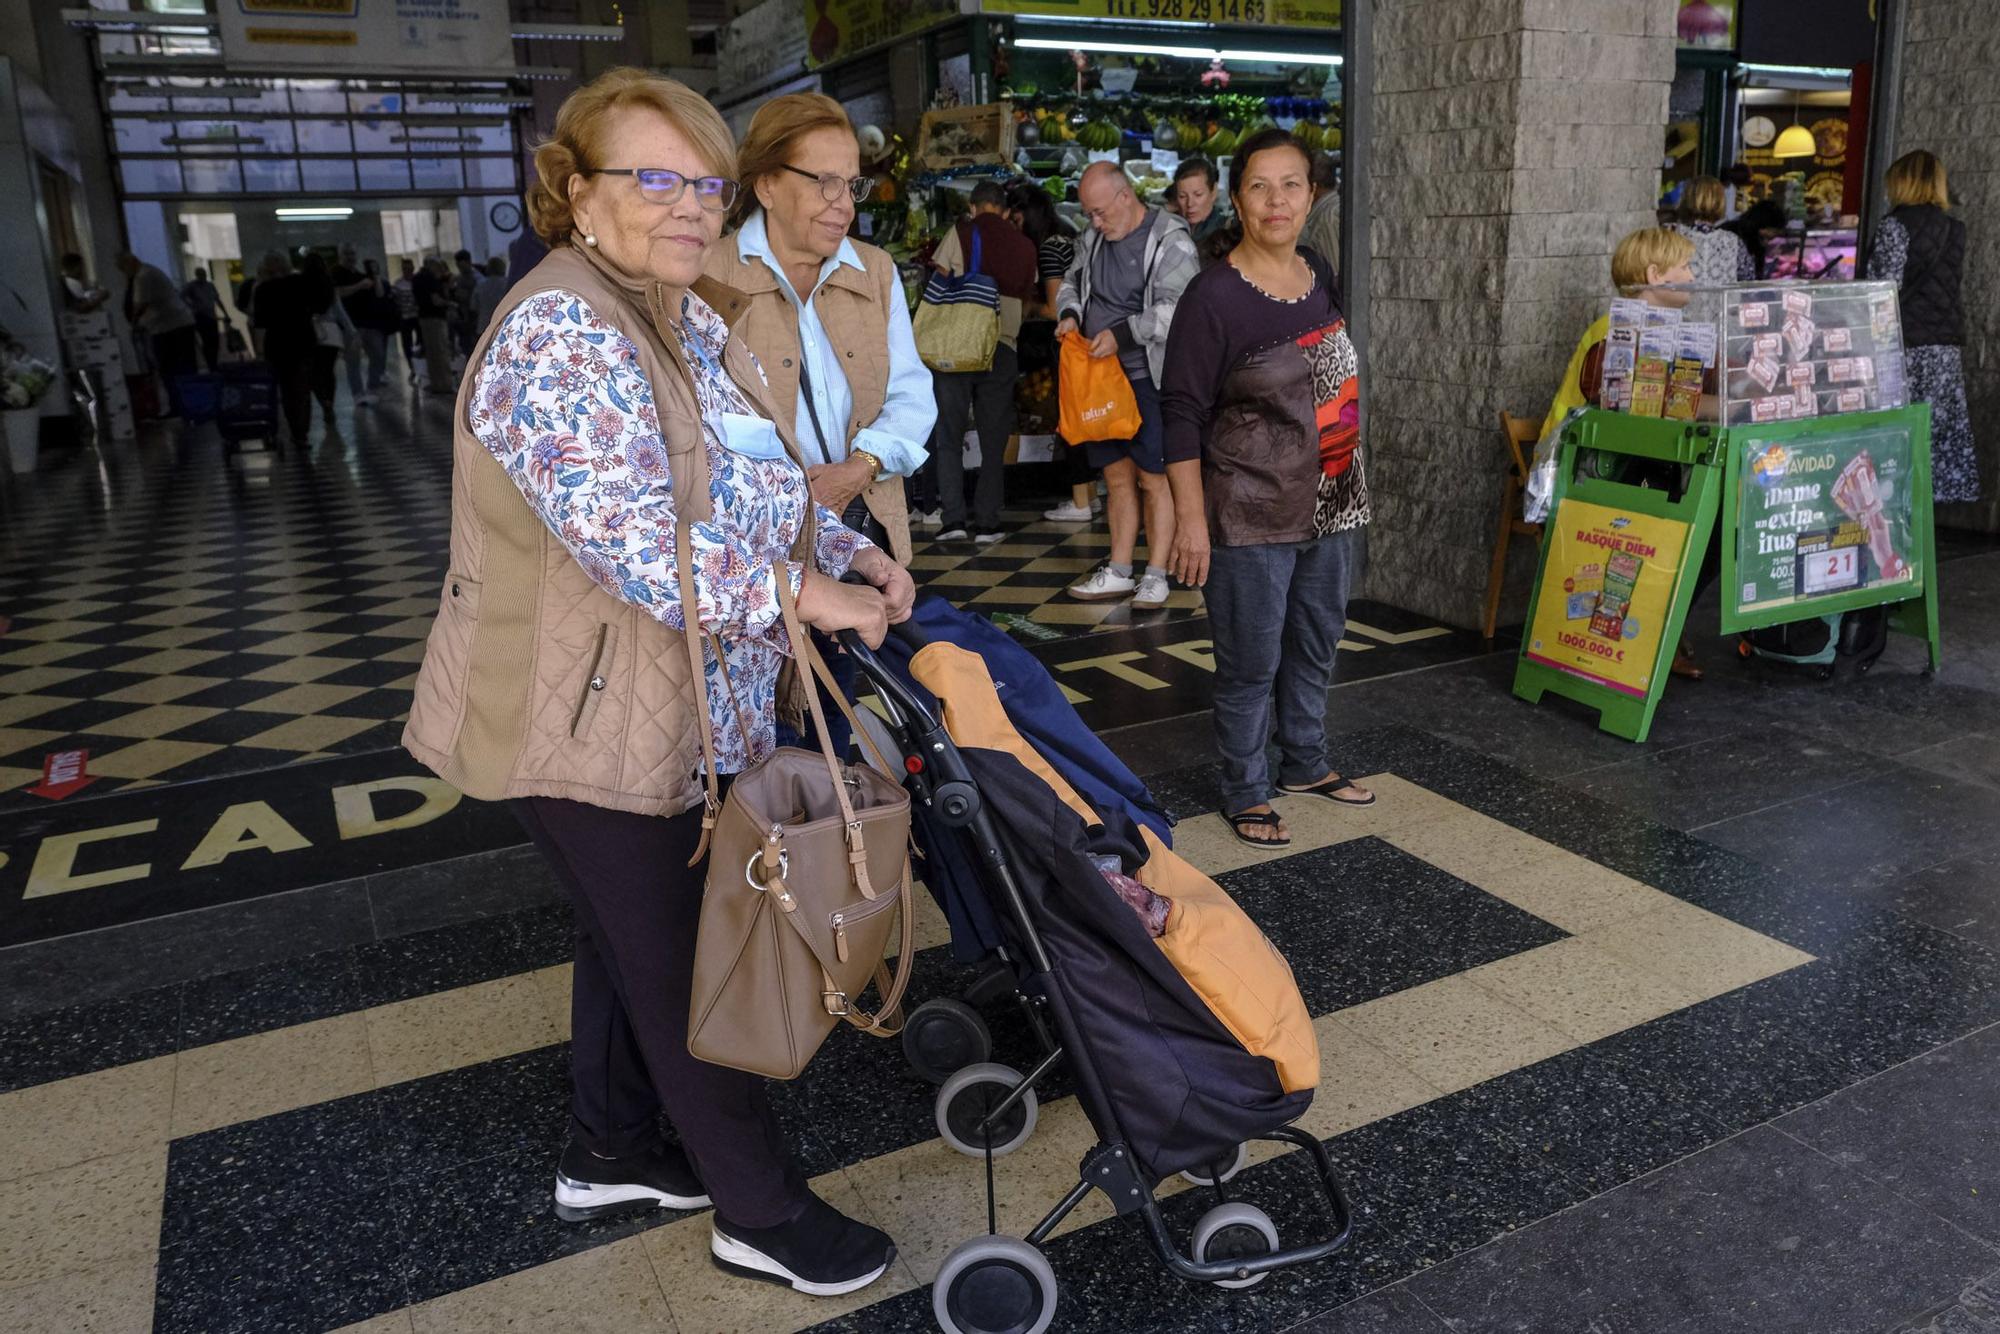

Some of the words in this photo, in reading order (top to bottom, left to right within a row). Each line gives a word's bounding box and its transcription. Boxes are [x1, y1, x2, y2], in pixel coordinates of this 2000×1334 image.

[1189, 0, 1211, 19] 29
[1217, 0, 1238, 22] 14
[1244, 0, 1265, 23] 63
[1576, 530, 1622, 550] RASQUE
[1625, 541, 1656, 557] DIEM
[1758, 528, 1800, 555] ilus
[0, 775, 462, 899] CAD
